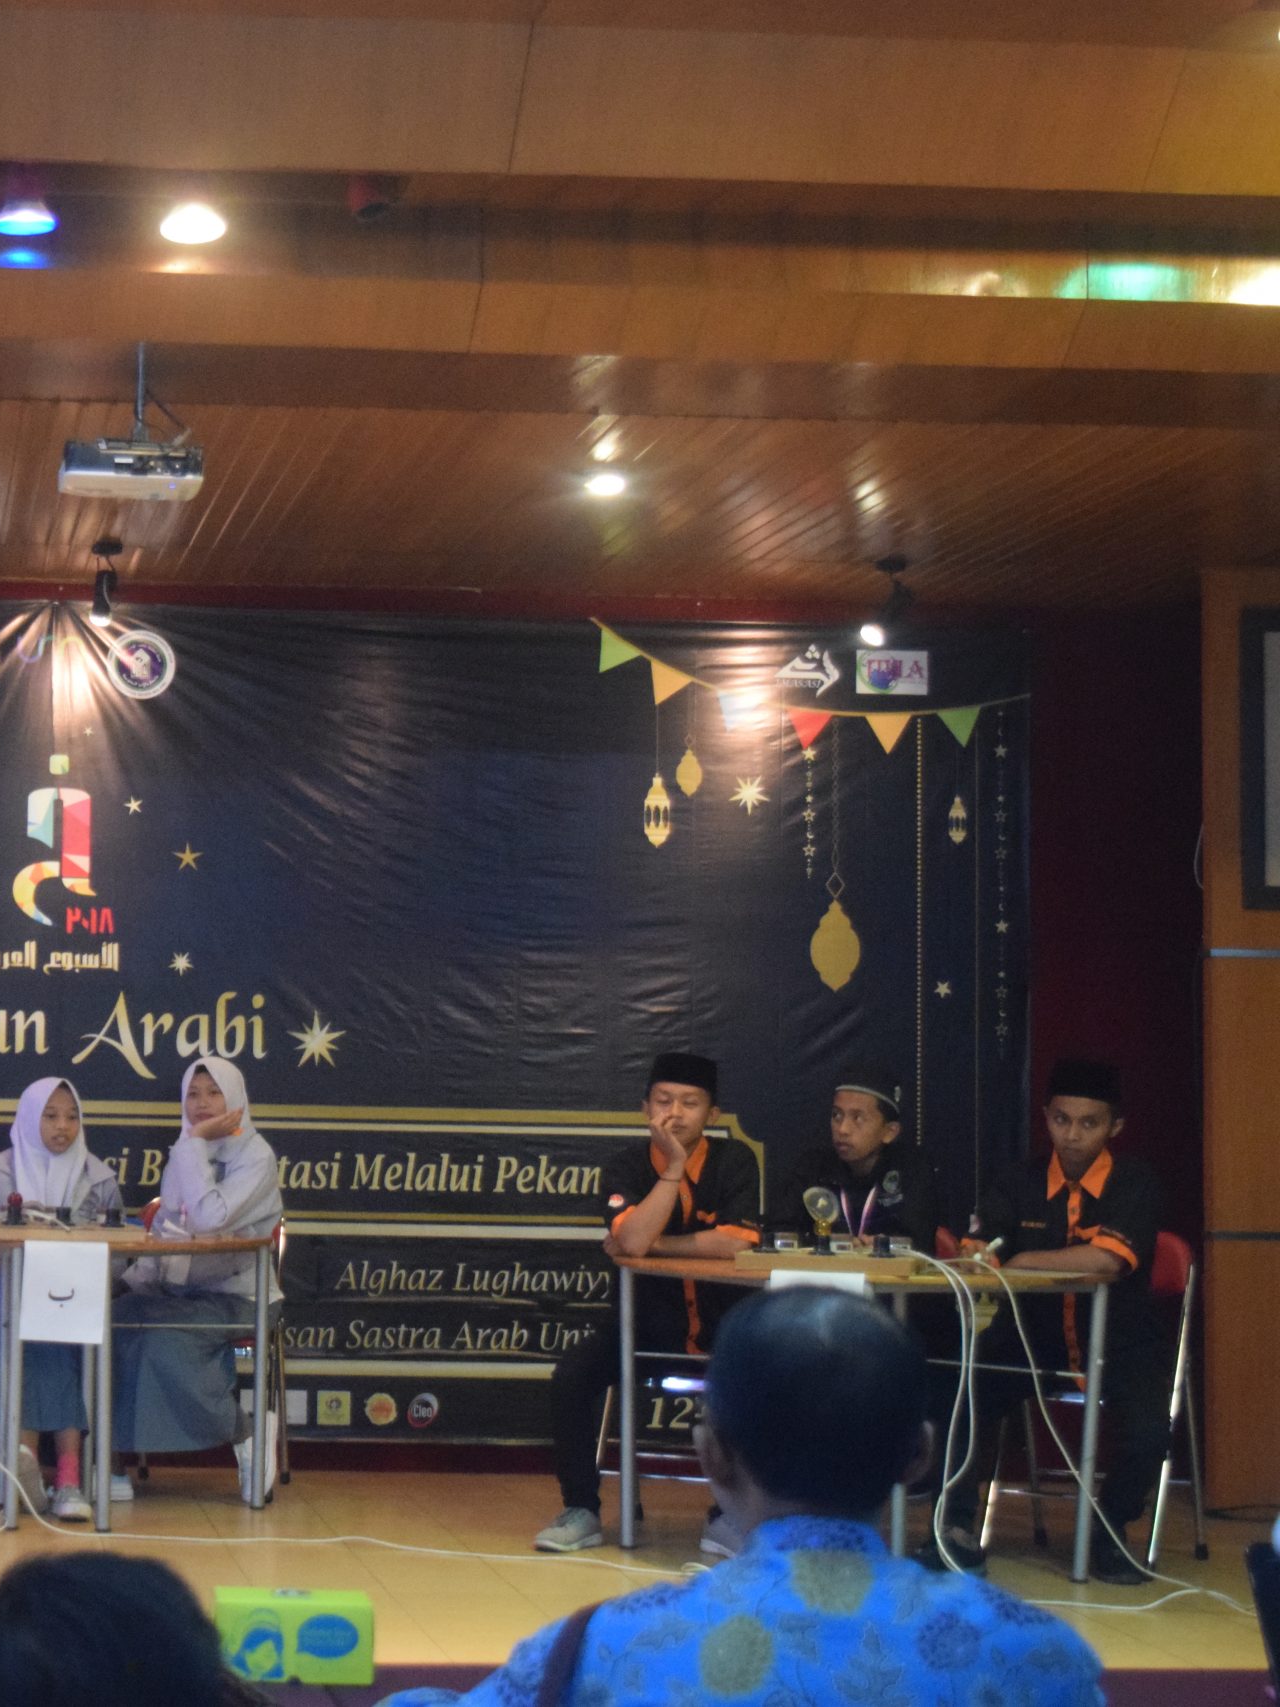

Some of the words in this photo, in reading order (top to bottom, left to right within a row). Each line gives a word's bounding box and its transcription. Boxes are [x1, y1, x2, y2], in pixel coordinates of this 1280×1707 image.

[71, 990, 267, 1079] Arabi
[350, 1152, 484, 1192] Melalui
[493, 1154, 601, 1195] Pekan
[335, 1260, 444, 1297] Alghaz
[345, 1319, 441, 1350] Sastra
[451, 1320, 529, 1350] Arab
[413, 1405, 433, 1418] Cleo
